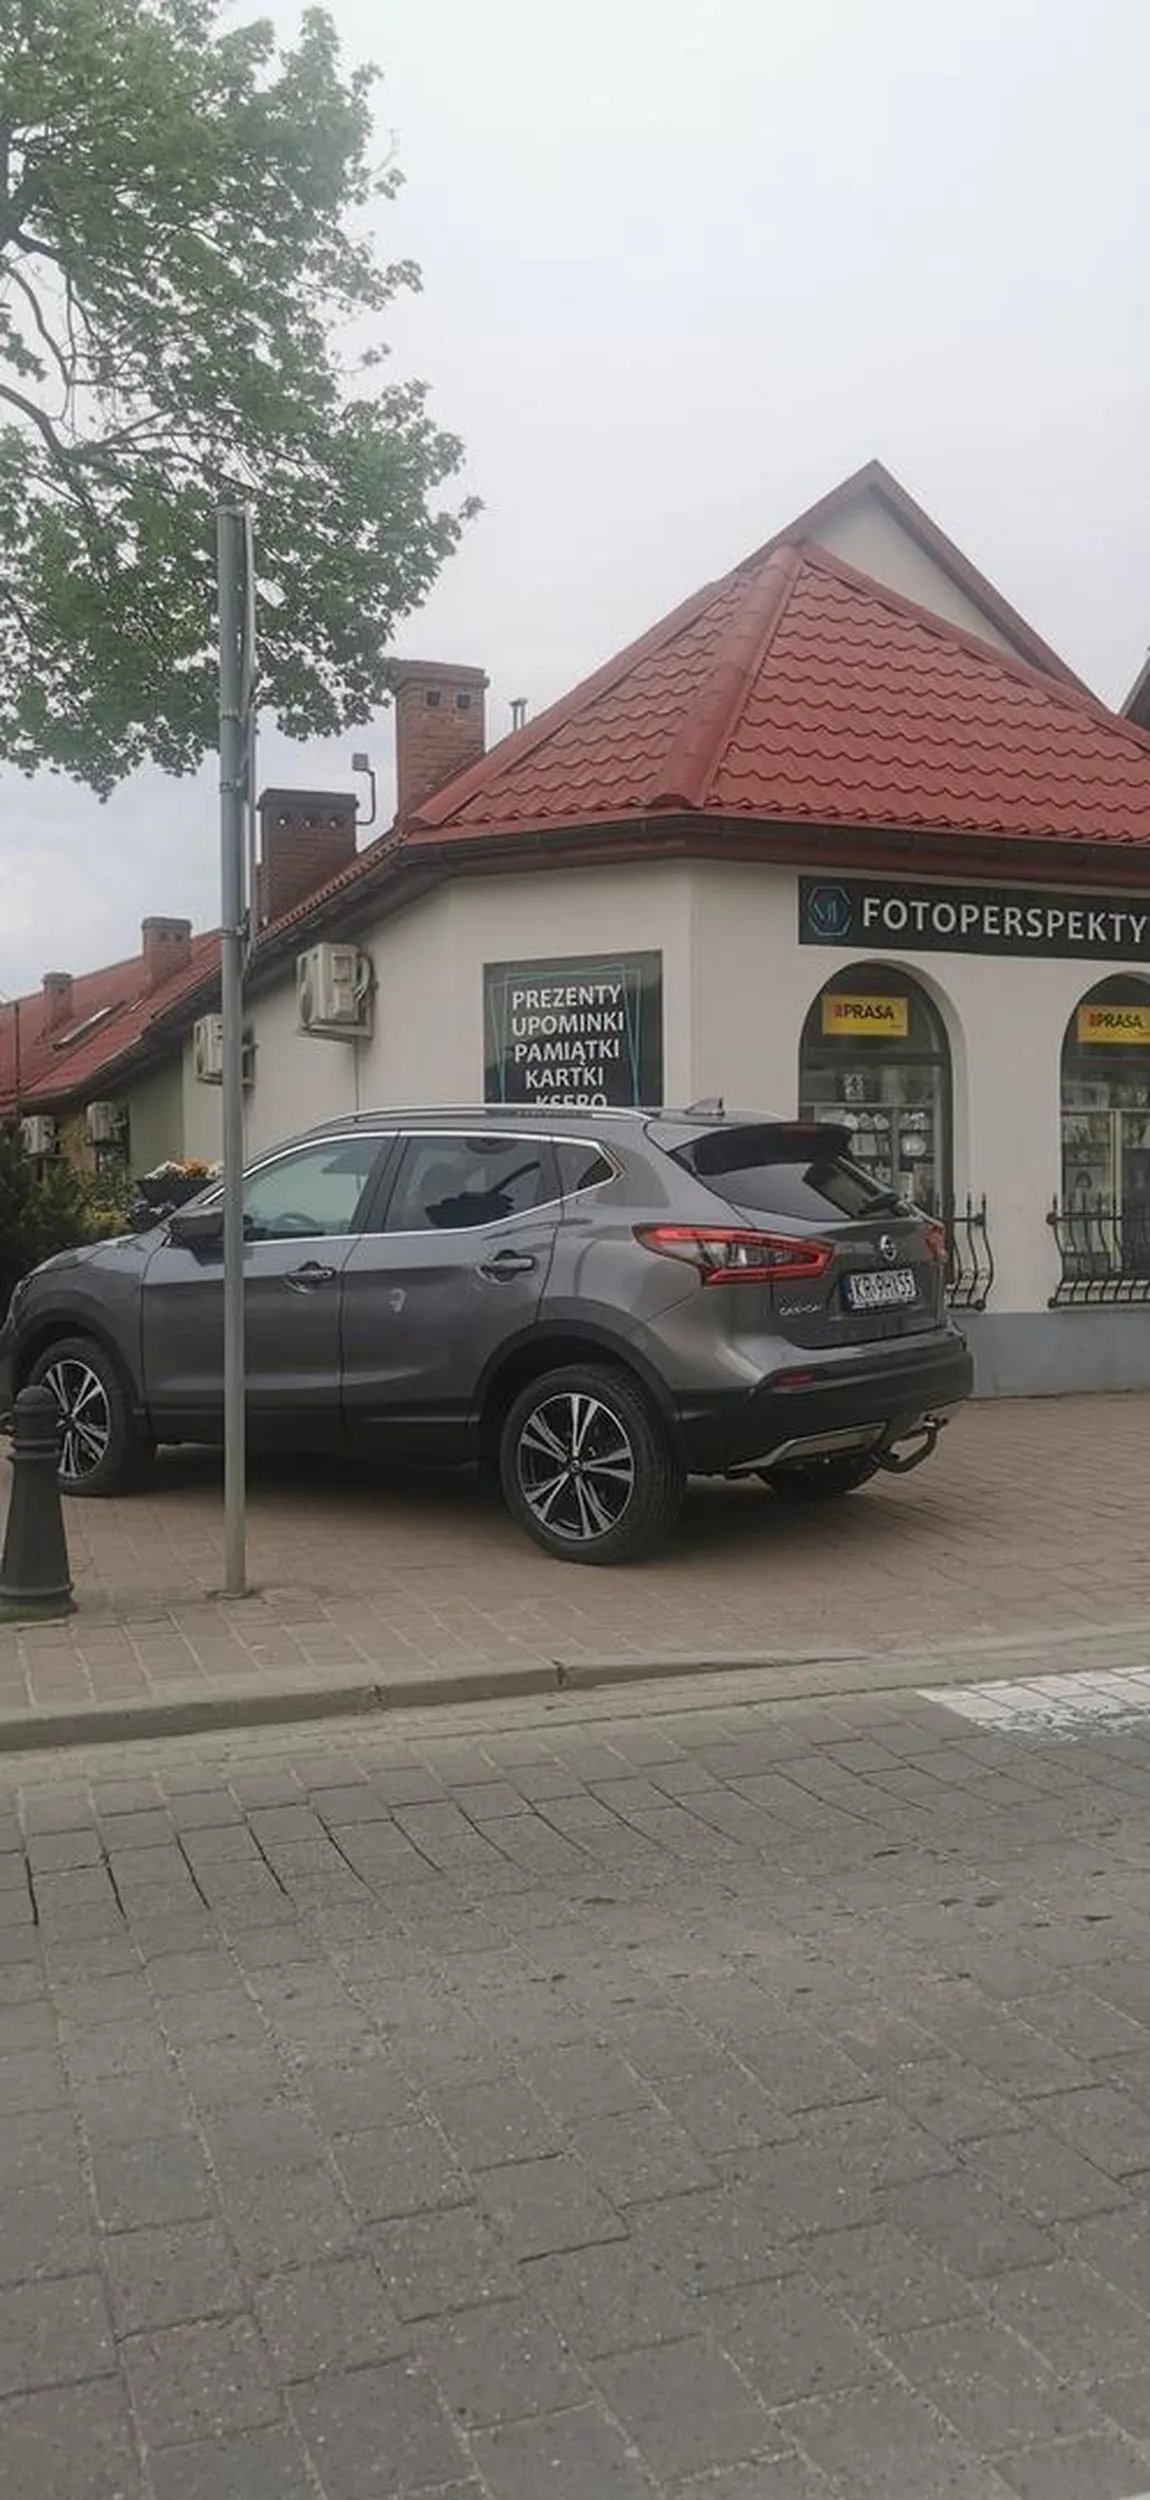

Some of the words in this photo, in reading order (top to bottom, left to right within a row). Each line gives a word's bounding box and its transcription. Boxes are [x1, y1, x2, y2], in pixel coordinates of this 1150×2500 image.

[862, 897, 1148, 943] FOTOPERSPEKTY
[512, 983, 622, 1010] PREZENTY
[512, 1011, 624, 1036] UPOMINKI
[514, 1039, 620, 1066] PAMIĄTKI
[525, 1066, 604, 1090] KARTKI
